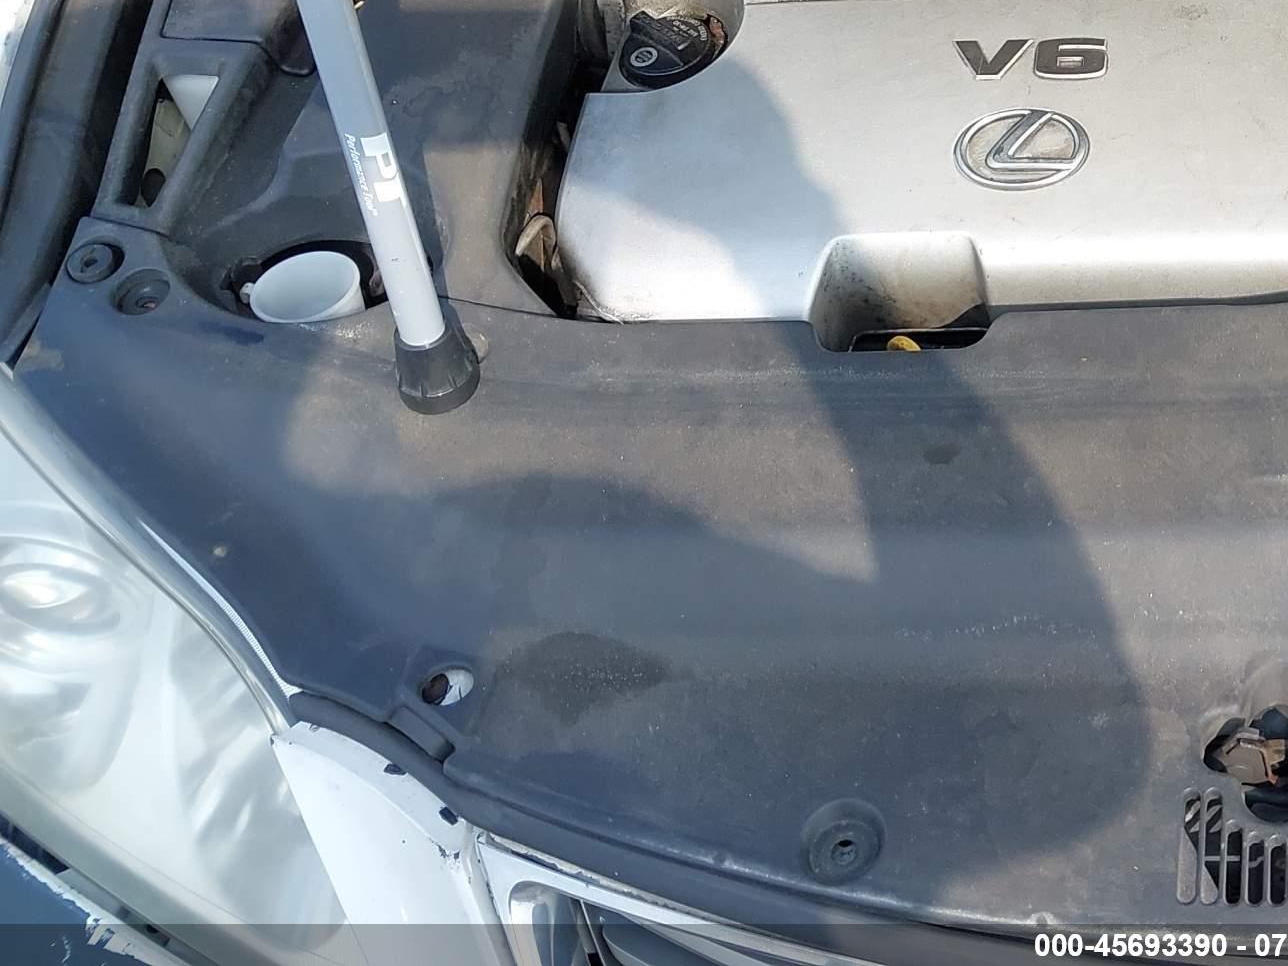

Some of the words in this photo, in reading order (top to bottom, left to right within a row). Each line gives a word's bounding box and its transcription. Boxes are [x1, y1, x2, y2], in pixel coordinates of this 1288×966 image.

[953, 37, 1109, 80] V6
[344, 133, 369, 191] Performance
[360, 132, 406, 209] PT
